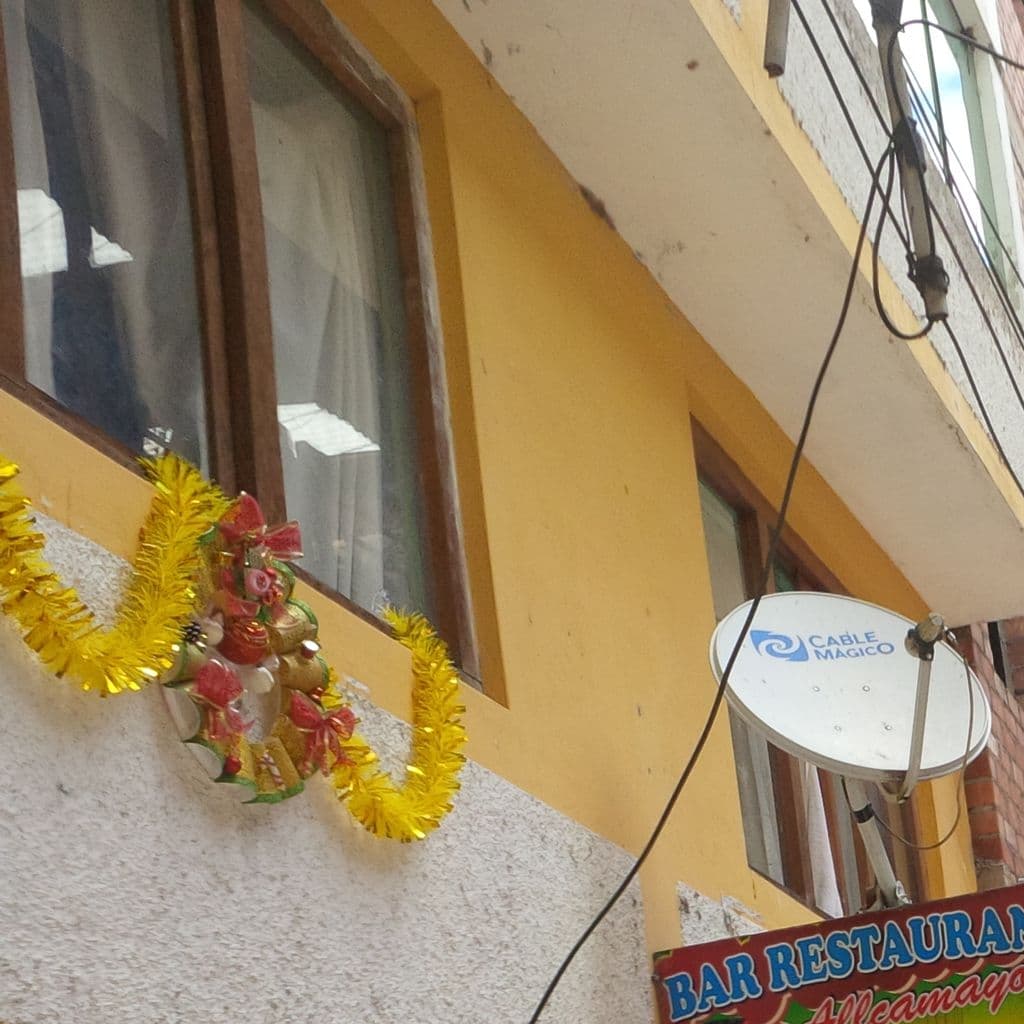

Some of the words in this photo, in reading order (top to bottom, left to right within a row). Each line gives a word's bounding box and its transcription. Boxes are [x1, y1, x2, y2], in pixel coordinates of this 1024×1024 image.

[809, 631, 879, 648] CABLE
[813, 642, 895, 661] MAGICO
[664, 949, 761, 1023] BAR
